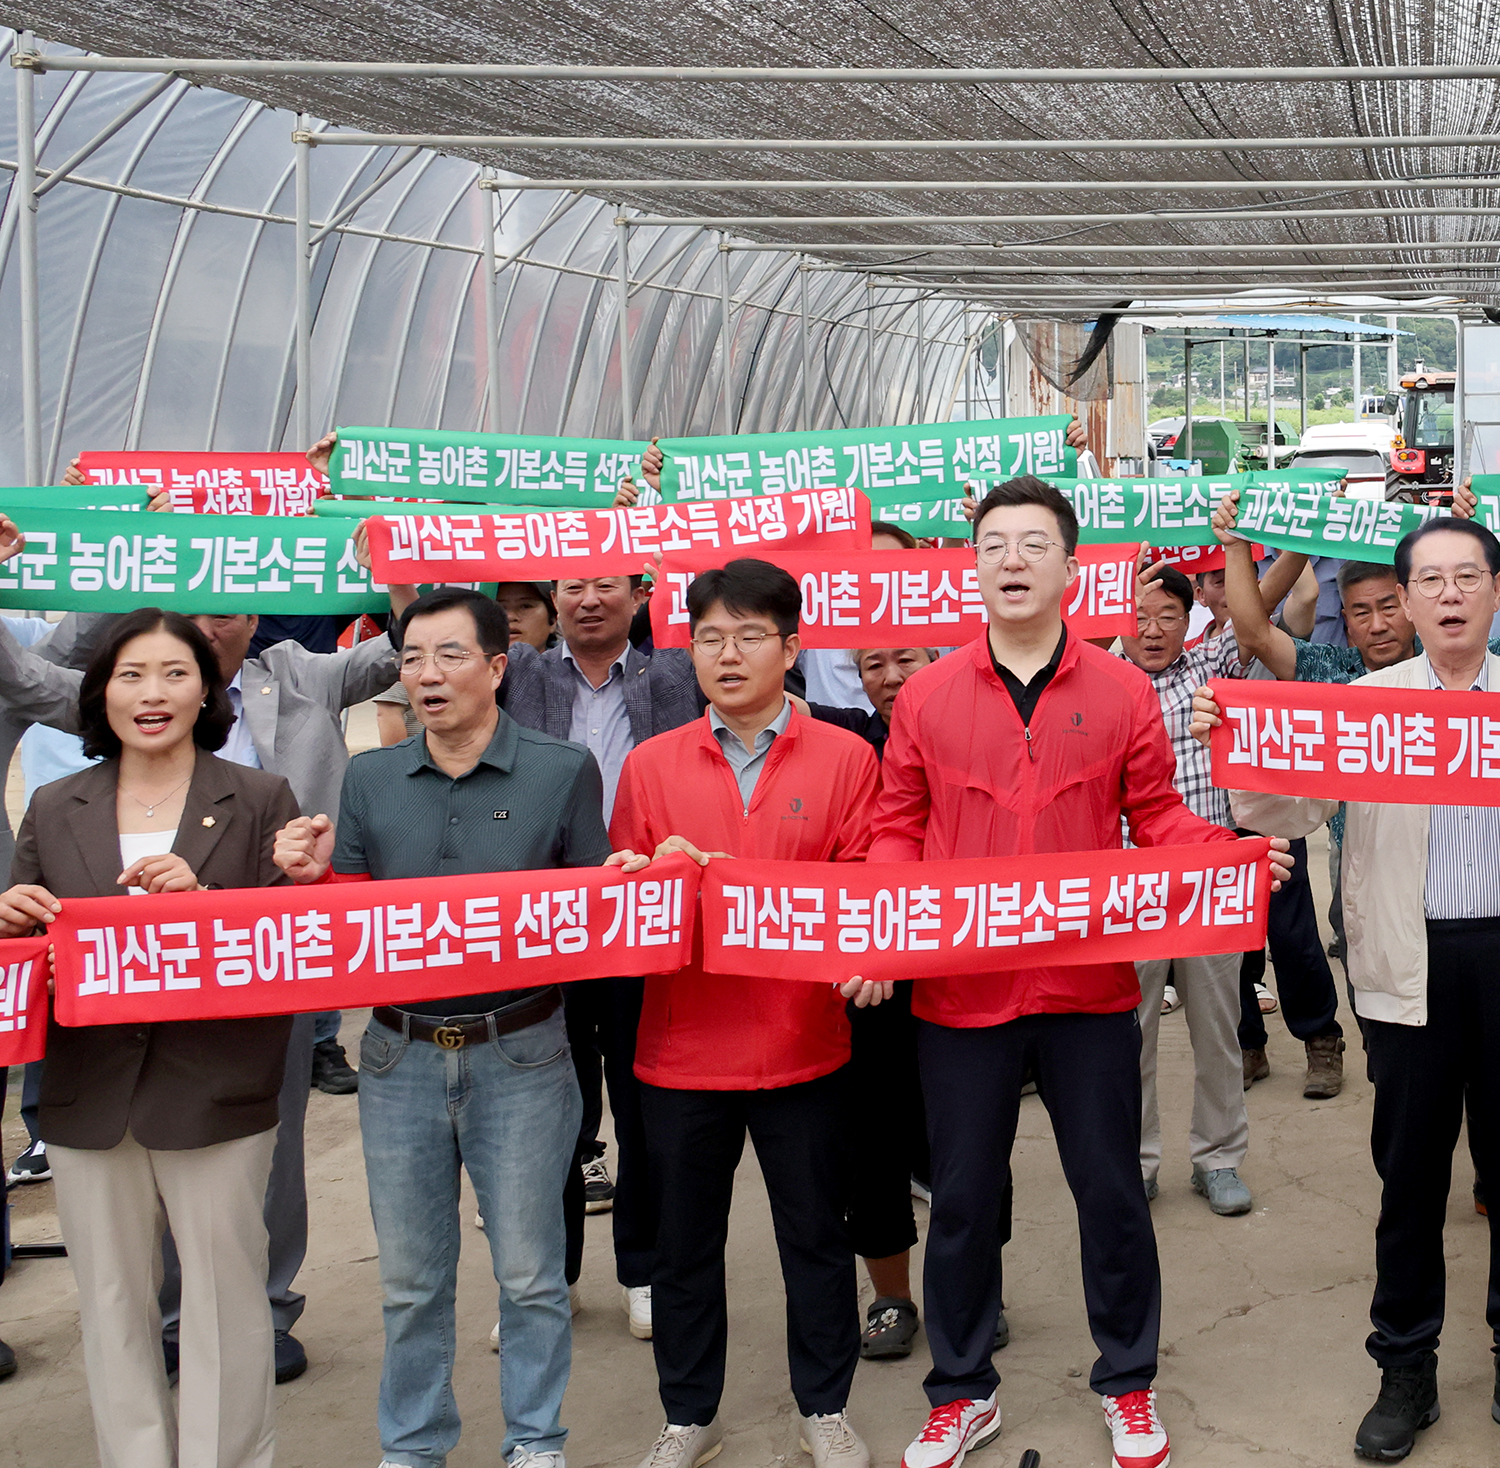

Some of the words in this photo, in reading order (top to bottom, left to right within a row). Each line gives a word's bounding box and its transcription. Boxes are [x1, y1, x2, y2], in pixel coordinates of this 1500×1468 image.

[340, 440, 411, 483] 괴산군
[418, 444, 488, 487] 농어촌
[495, 449, 587, 492] 기본소득
[676, 452, 752, 501] 괴산군
[759, 445, 834, 493] 농어촌
[842, 438, 944, 490] 기본소득
[952, 435, 1001, 482] 선정
[1008, 429, 1064, 475] 기원!
[384, 514, 485, 560] 괴산군
[493, 511, 590, 560] 농어촌
[600, 500, 720, 553] 기본소득
[727, 494, 786, 545] 선정
[797, 486, 857, 535] 기원!
[1237, 489, 1320, 538] 괴산군
[1323, 497, 1403, 546] 농어촌
[69, 533, 177, 592] 농어촌
[188, 537, 323, 593] 기본소득
[1068, 561, 1134, 616] 기원!
[1226, 707, 1325, 771] 괴산군
[1337, 711, 1435, 775] 농어촌
[78, 922, 200, 996] 괴산군
[214, 910, 333, 986] 농어촌
[347, 897, 500, 973] 기본소득
[515, 888, 588, 958] 선정
[602, 879, 682, 946] 기원!
[723, 886, 825, 951] 괴산군
[838, 885, 941, 952] 농어촌
[953, 878, 1090, 947] 기본소득
[1103, 872, 1169, 934] 선정
[1179, 863, 1256, 925] 기원!
